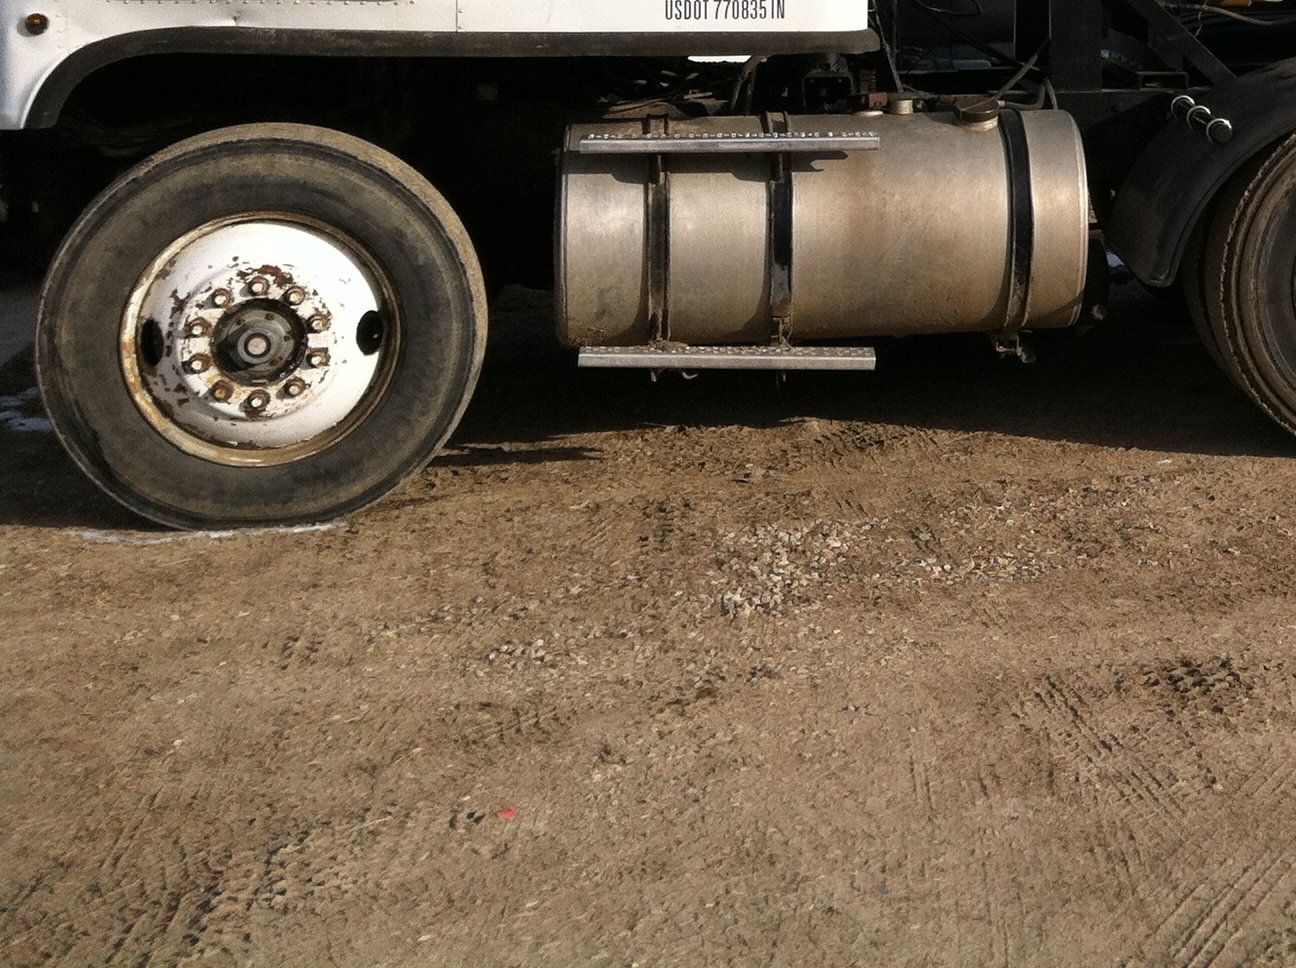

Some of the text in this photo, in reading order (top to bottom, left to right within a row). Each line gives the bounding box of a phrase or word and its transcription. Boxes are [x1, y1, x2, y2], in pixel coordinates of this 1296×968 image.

[665, 0, 785, 20] USDOT 770835 IN
